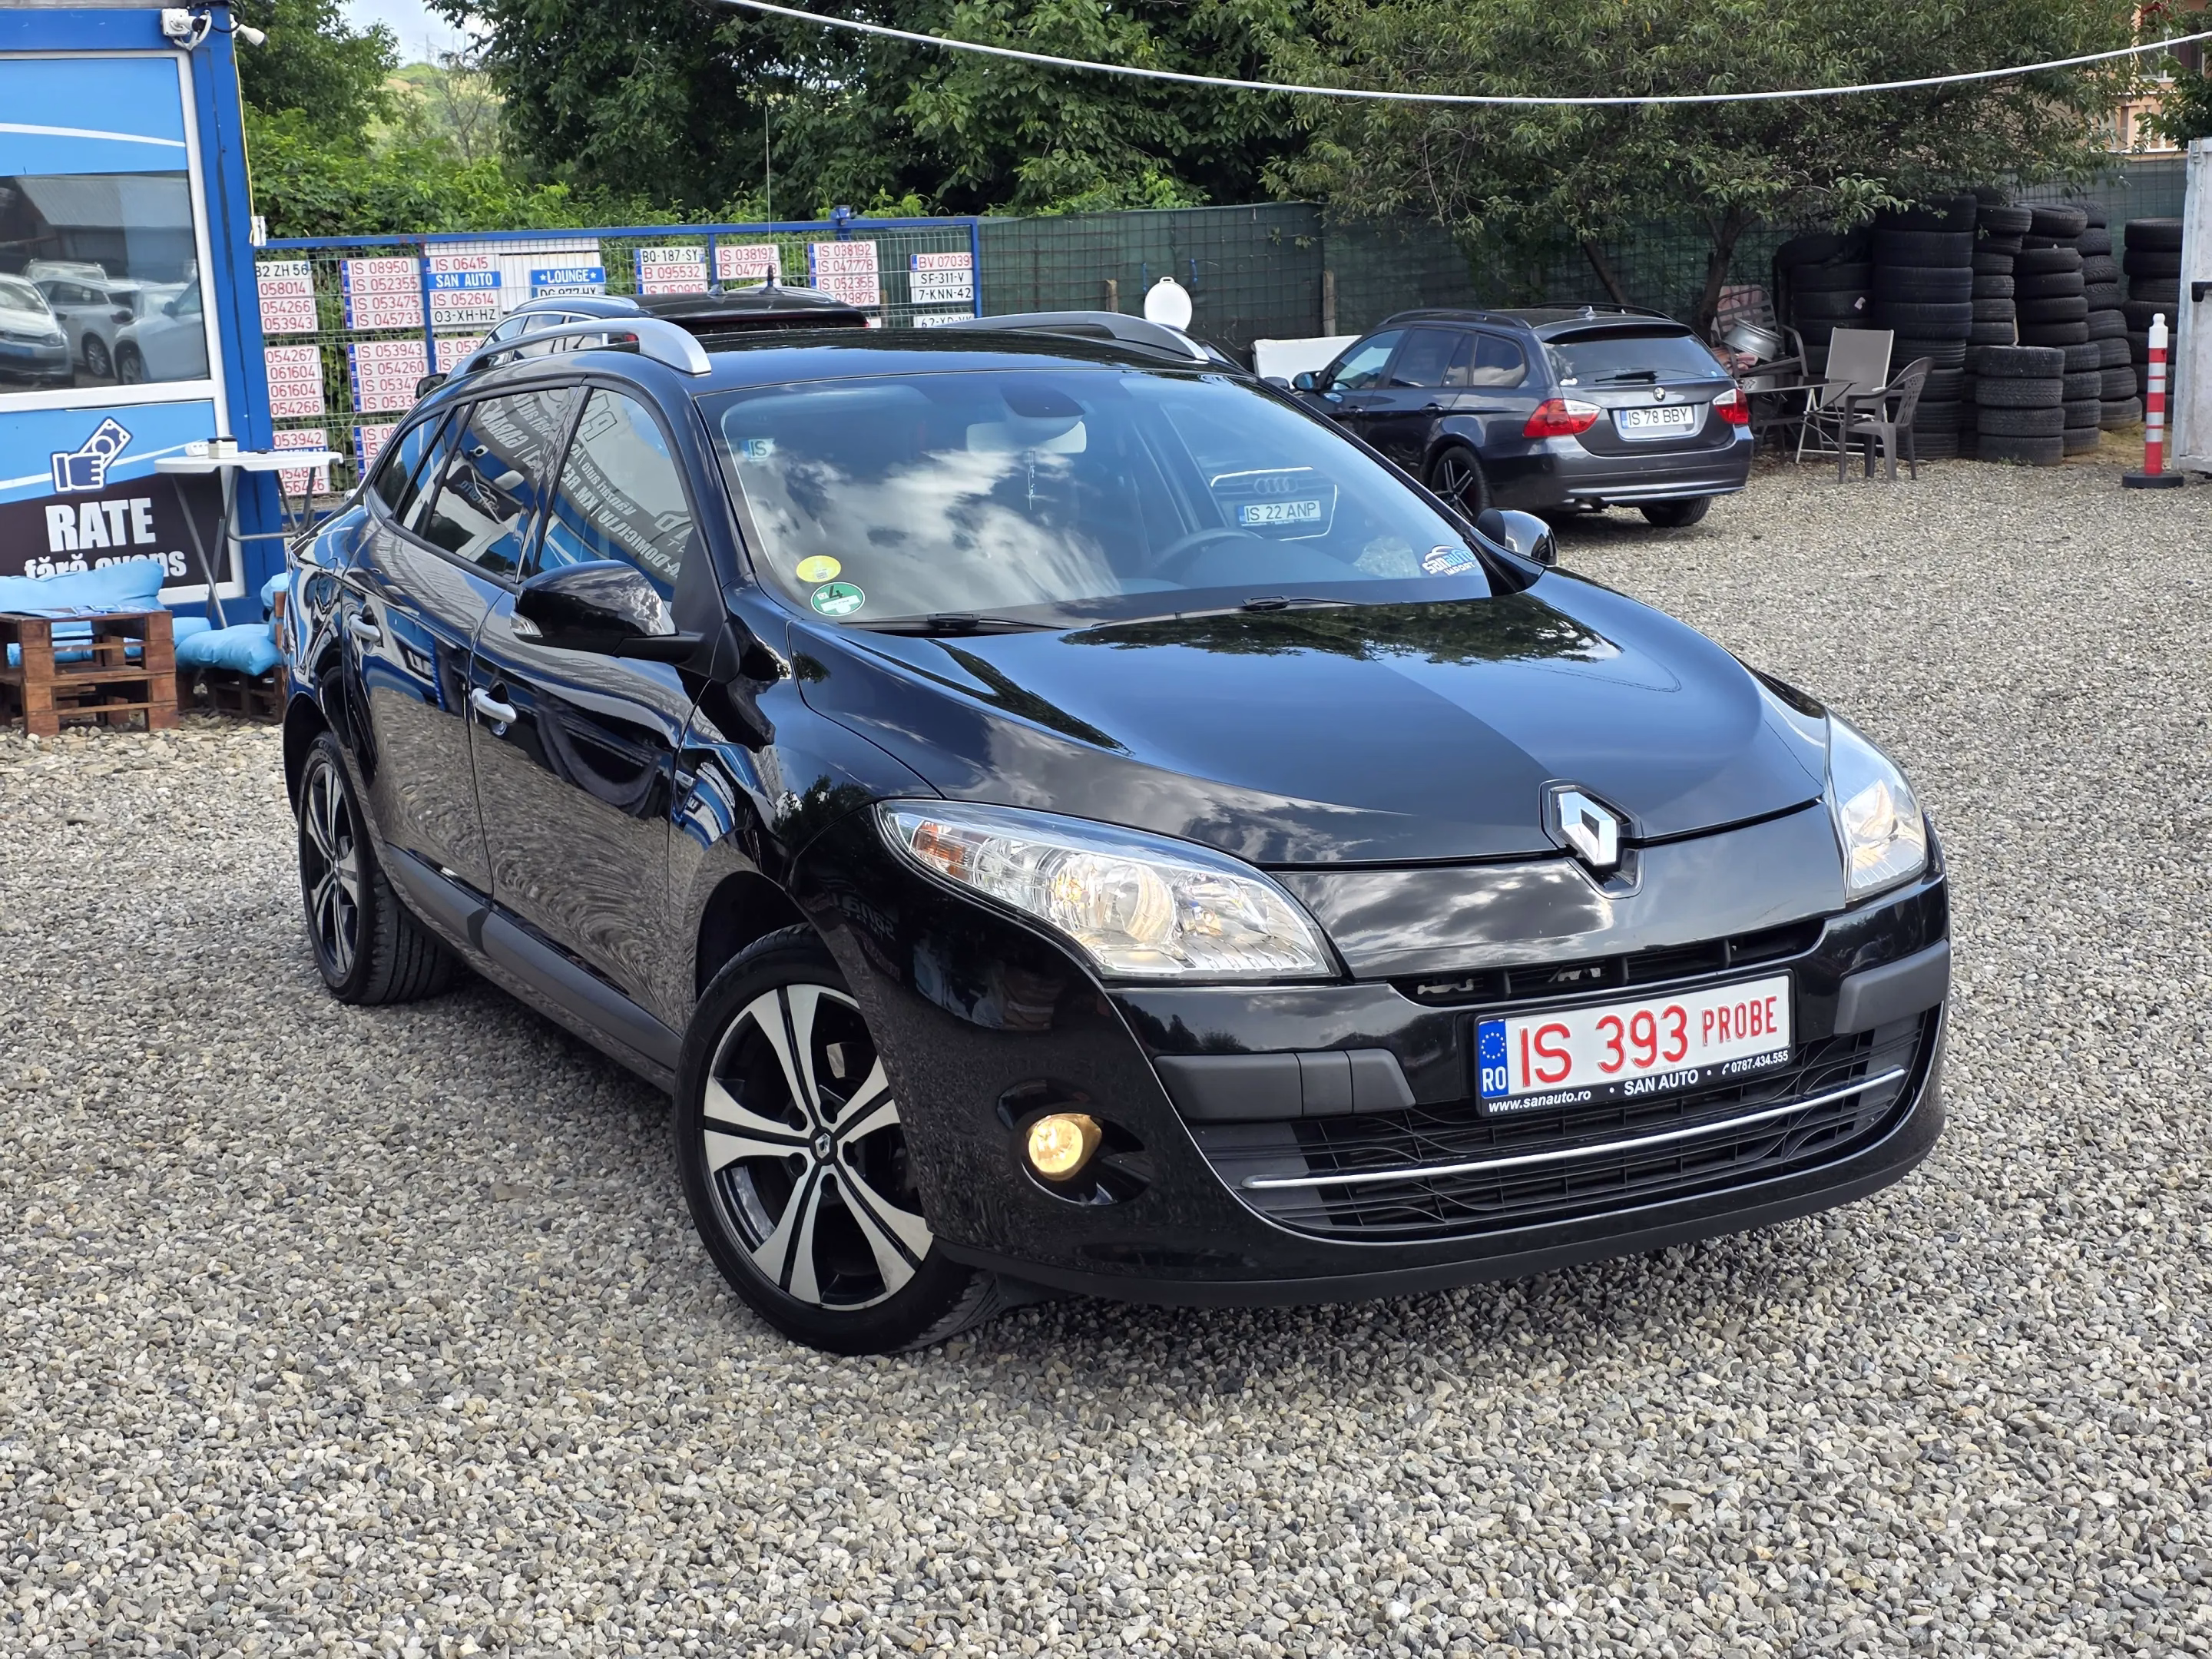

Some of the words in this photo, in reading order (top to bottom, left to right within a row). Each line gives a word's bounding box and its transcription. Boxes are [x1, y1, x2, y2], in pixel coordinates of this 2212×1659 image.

[719, 249, 732, 262] IS
[819, 245, 830, 257] IS
[273, 264, 290, 276] ZH
[293, 263, 309, 276] 56
[351, 262, 364, 276] IS
[369, 260, 409, 274] 08950
[435, 258, 449, 272] IS
[452, 257, 488, 270] 06415
[720, 263, 732, 277] IS
[818, 260, 830, 273] IS
[919, 257, 935, 269] BV
[546, 269, 590, 283] LOUNGE
[644, 267, 653, 280] B
[657, 265, 700, 279] 095532
[920, 272, 965, 285] SF-311-V
[353, 279, 366, 292] IS
[370, 276, 418, 291] 052355
[435, 273, 459, 288] SAN
[464, 273, 493, 287] AUTO
[819, 277, 830, 290] IS
[260, 281, 306, 296] 058014
[918, 287, 972, 300] 7-KNN-42
[354, 297, 367, 311] IS
[372, 295, 419, 310] 053475
[433, 293, 447, 307] IS
[451, 292, 495, 306] 052614
[262, 300, 311, 315] 054266
[356, 313, 369, 327] IS
[374, 311, 421, 326] 045733
[434, 308, 496, 323] 03-XH-HZ
[264, 316, 313, 331] 053943
[358, 345, 371, 359] IS
[375, 343, 422, 358] 053943
[439, 341, 452, 355] IS
[455, 339, 483, 353] 053
[266, 348, 315, 364] 054267
[270, 364, 316, 380] 061604
[359, 363, 373, 376] IS
[377, 360, 425, 375] 054260
[439, 358, 452, 371] IS
[270, 383, 316, 398] 061604
[362, 379, 376, 392] IS
[271, 400, 320, 416] 054266
[363, 396, 377, 410] IS
[381, 394, 418, 409] 0533
[1628, 412, 1641, 426] IS
[1644, 411, 1659, 425] 78
[1663, 408, 1687, 423] BBY
[273, 432, 323, 447] 053942
[363, 428, 376, 441] IS
[365, 442, 379, 455] IS
[750, 440, 767, 459] IS
[1245, 507, 1260, 522] IS
[1266, 505, 1283, 520] 22
[1286, 502, 1316, 518] ANP
[45, 497, 157, 553] RATE
[1518, 1023, 1573, 1088] IS
[1594, 1002, 1689, 1074] 393
[1700, 995, 1778, 1047] PROBE
[1482, 1066, 1507, 1093] RO
[1488, 1089, 1591, 1114] www.sanauto.ro
[1624, 1078, 1660, 1096] SAN
[1657, 1069, 1699, 1091] AUTO
[1730, 1050, 1790, 1074] 0787.434.555
